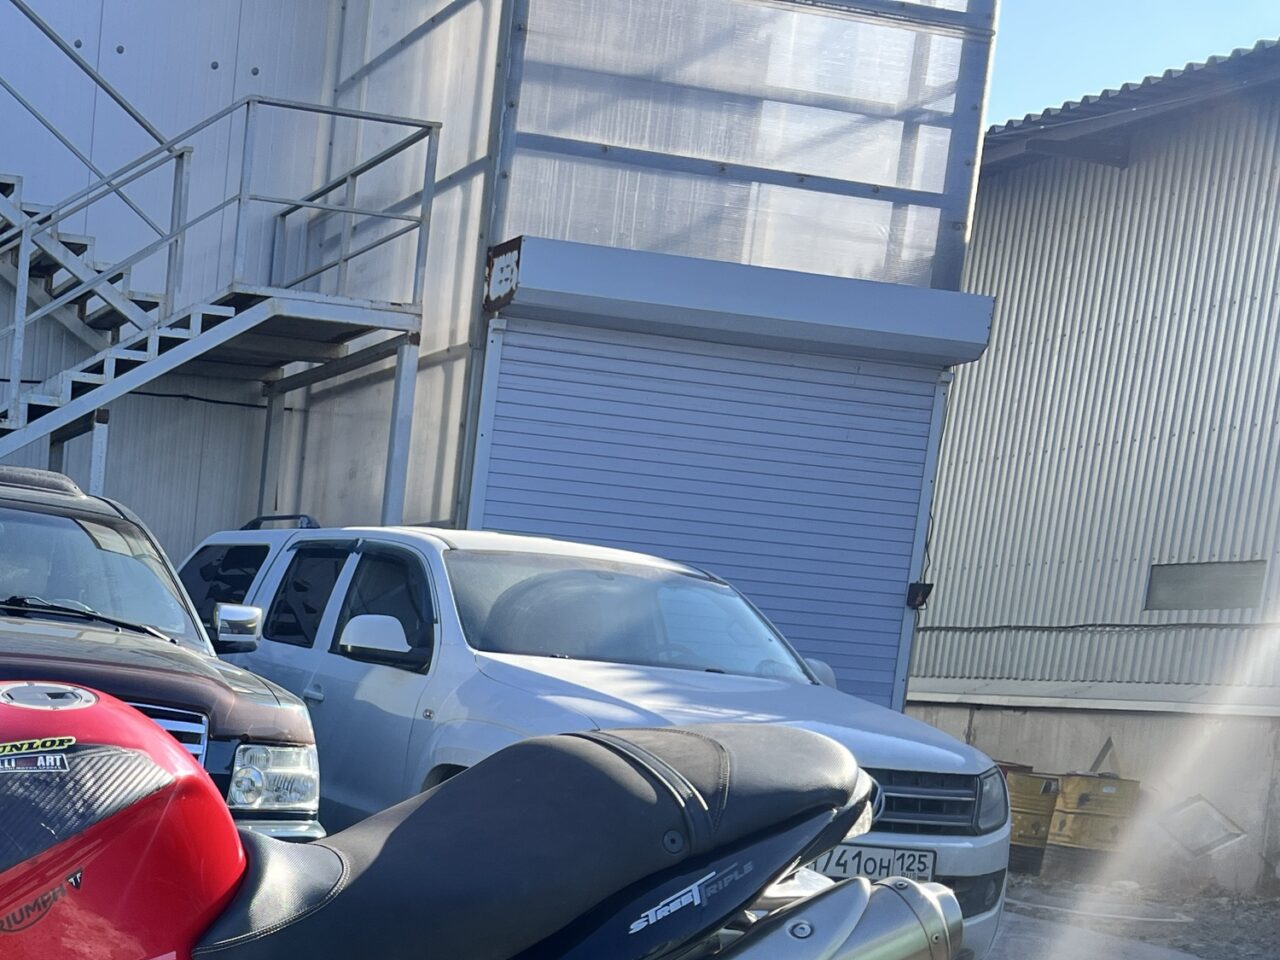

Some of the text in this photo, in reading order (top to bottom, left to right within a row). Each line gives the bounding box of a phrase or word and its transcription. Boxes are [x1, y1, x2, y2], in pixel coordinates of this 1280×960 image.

[37, 754, 62, 767] ART
[807, 849, 928, 877] 741ОН 125
